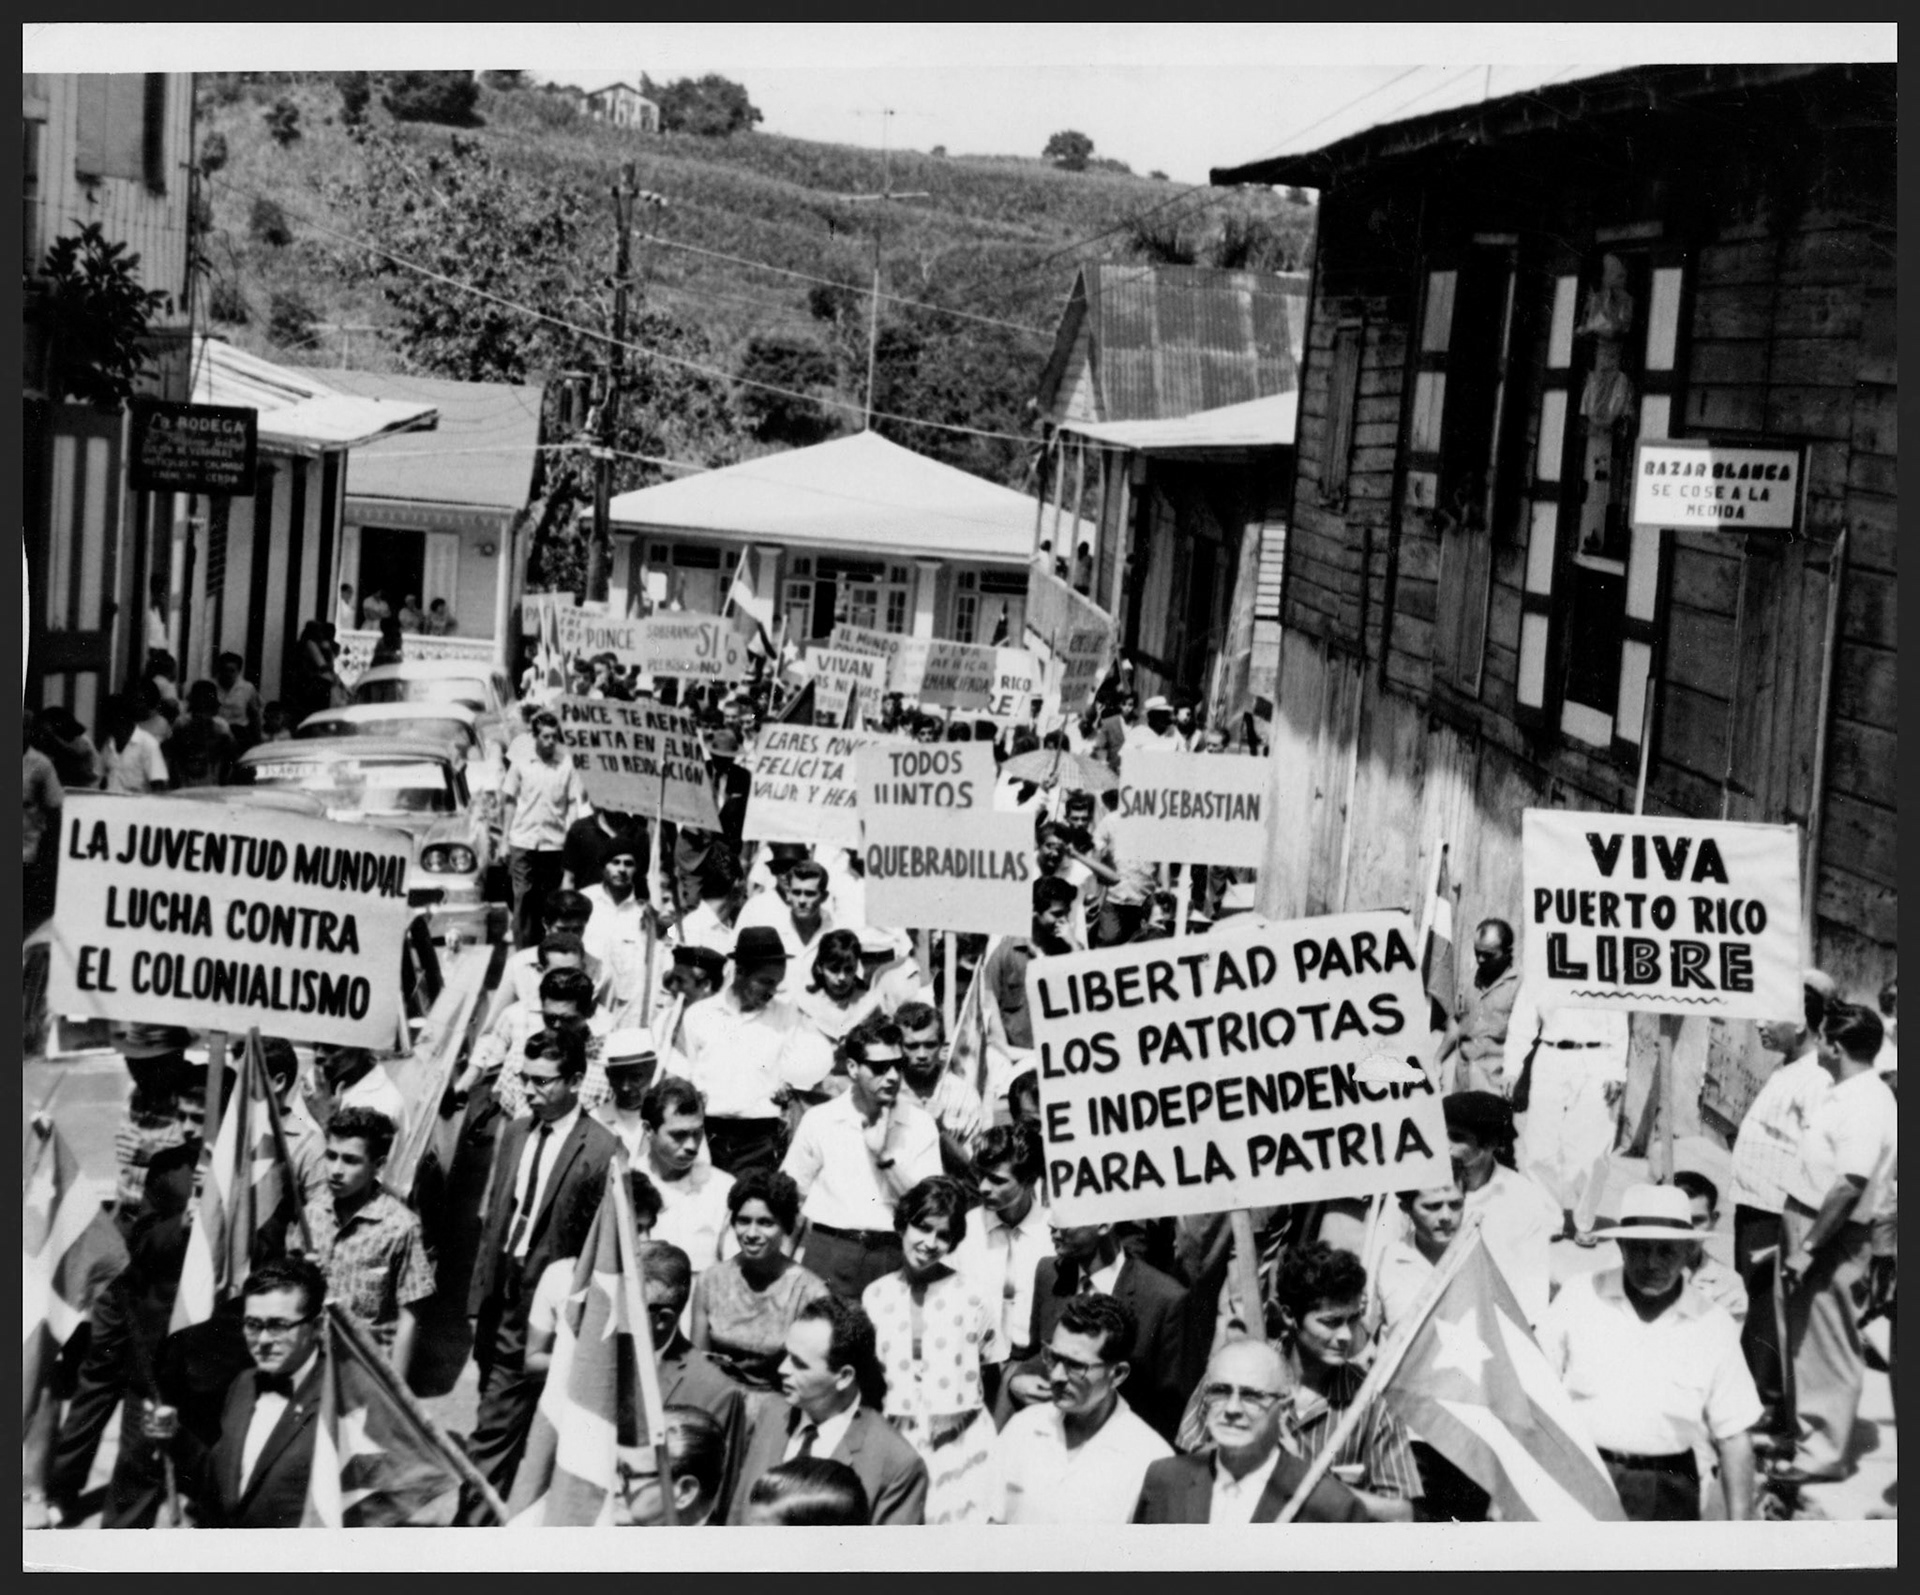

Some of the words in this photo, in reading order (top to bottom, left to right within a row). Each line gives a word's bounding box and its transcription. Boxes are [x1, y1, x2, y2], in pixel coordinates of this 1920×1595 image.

[177, 415, 244, 434] BODEGA
[1644, 461, 1706, 477] BAZAR
[1711, 462, 1790, 481] BLANCA
[1651, 484, 1672, 497] SE
[1679, 485, 1724, 500] COSE
[1731, 486, 1741, 500] A
[1748, 487, 1769, 502] LA
[1686, 504, 1745, 519] MEDIDA
[586, 627, 635, 651] PONCE
[817, 654, 874, 679] VIVAN
[1001, 675, 1033, 692] RICO
[561, 703, 613, 724] PONCE
[617, 708, 642, 727] TE
[564, 729, 627, 750] SENTA
[634, 733, 656, 753] EN
[765, 731, 819, 753] LARES
[572, 753, 591, 770] DE
[597, 754, 619, 772] TU
[756, 756, 844, 780] FELICITA
[888, 750, 962, 777] TODOS
[754, 781, 799, 801] VALOR
[808, 784, 820, 804] Y
[1121, 785, 1157, 818] SAN
[1159, 788, 1260, 821] SEBASTIAN
[69, 818, 109, 861] LA
[116, 823, 288, 881] JUVENTUD
[293, 843, 407, 898] MUNDIAL
[866, 843, 1029, 882] QUEBRADILLAS
[1585, 832, 1729, 884] VIVA
[105, 885, 212, 937] LUCHA
[226, 899, 360, 955] CONTRA
[1534, 887, 1676, 931] PUERTO
[1688, 896, 1767, 935] RICO
[1037, 945, 1277, 1018] LIBERTAD
[1293, 928, 1416, 983] PARA
[1547, 932, 1754, 993] LIBRE
[76, 945, 117, 993] EL
[131, 950, 371, 1020] COLONIALISMO
[1041, 1031, 1120, 1079] LOS
[1138, 993, 1405, 1065] PATRIOTAS
[1046, 1102, 1075, 1143] E
[1049, 1150, 1165, 1198] PARA
[1173, 1141, 1236, 1186] LA
[1246, 1117, 1434, 1177] PATRIA
